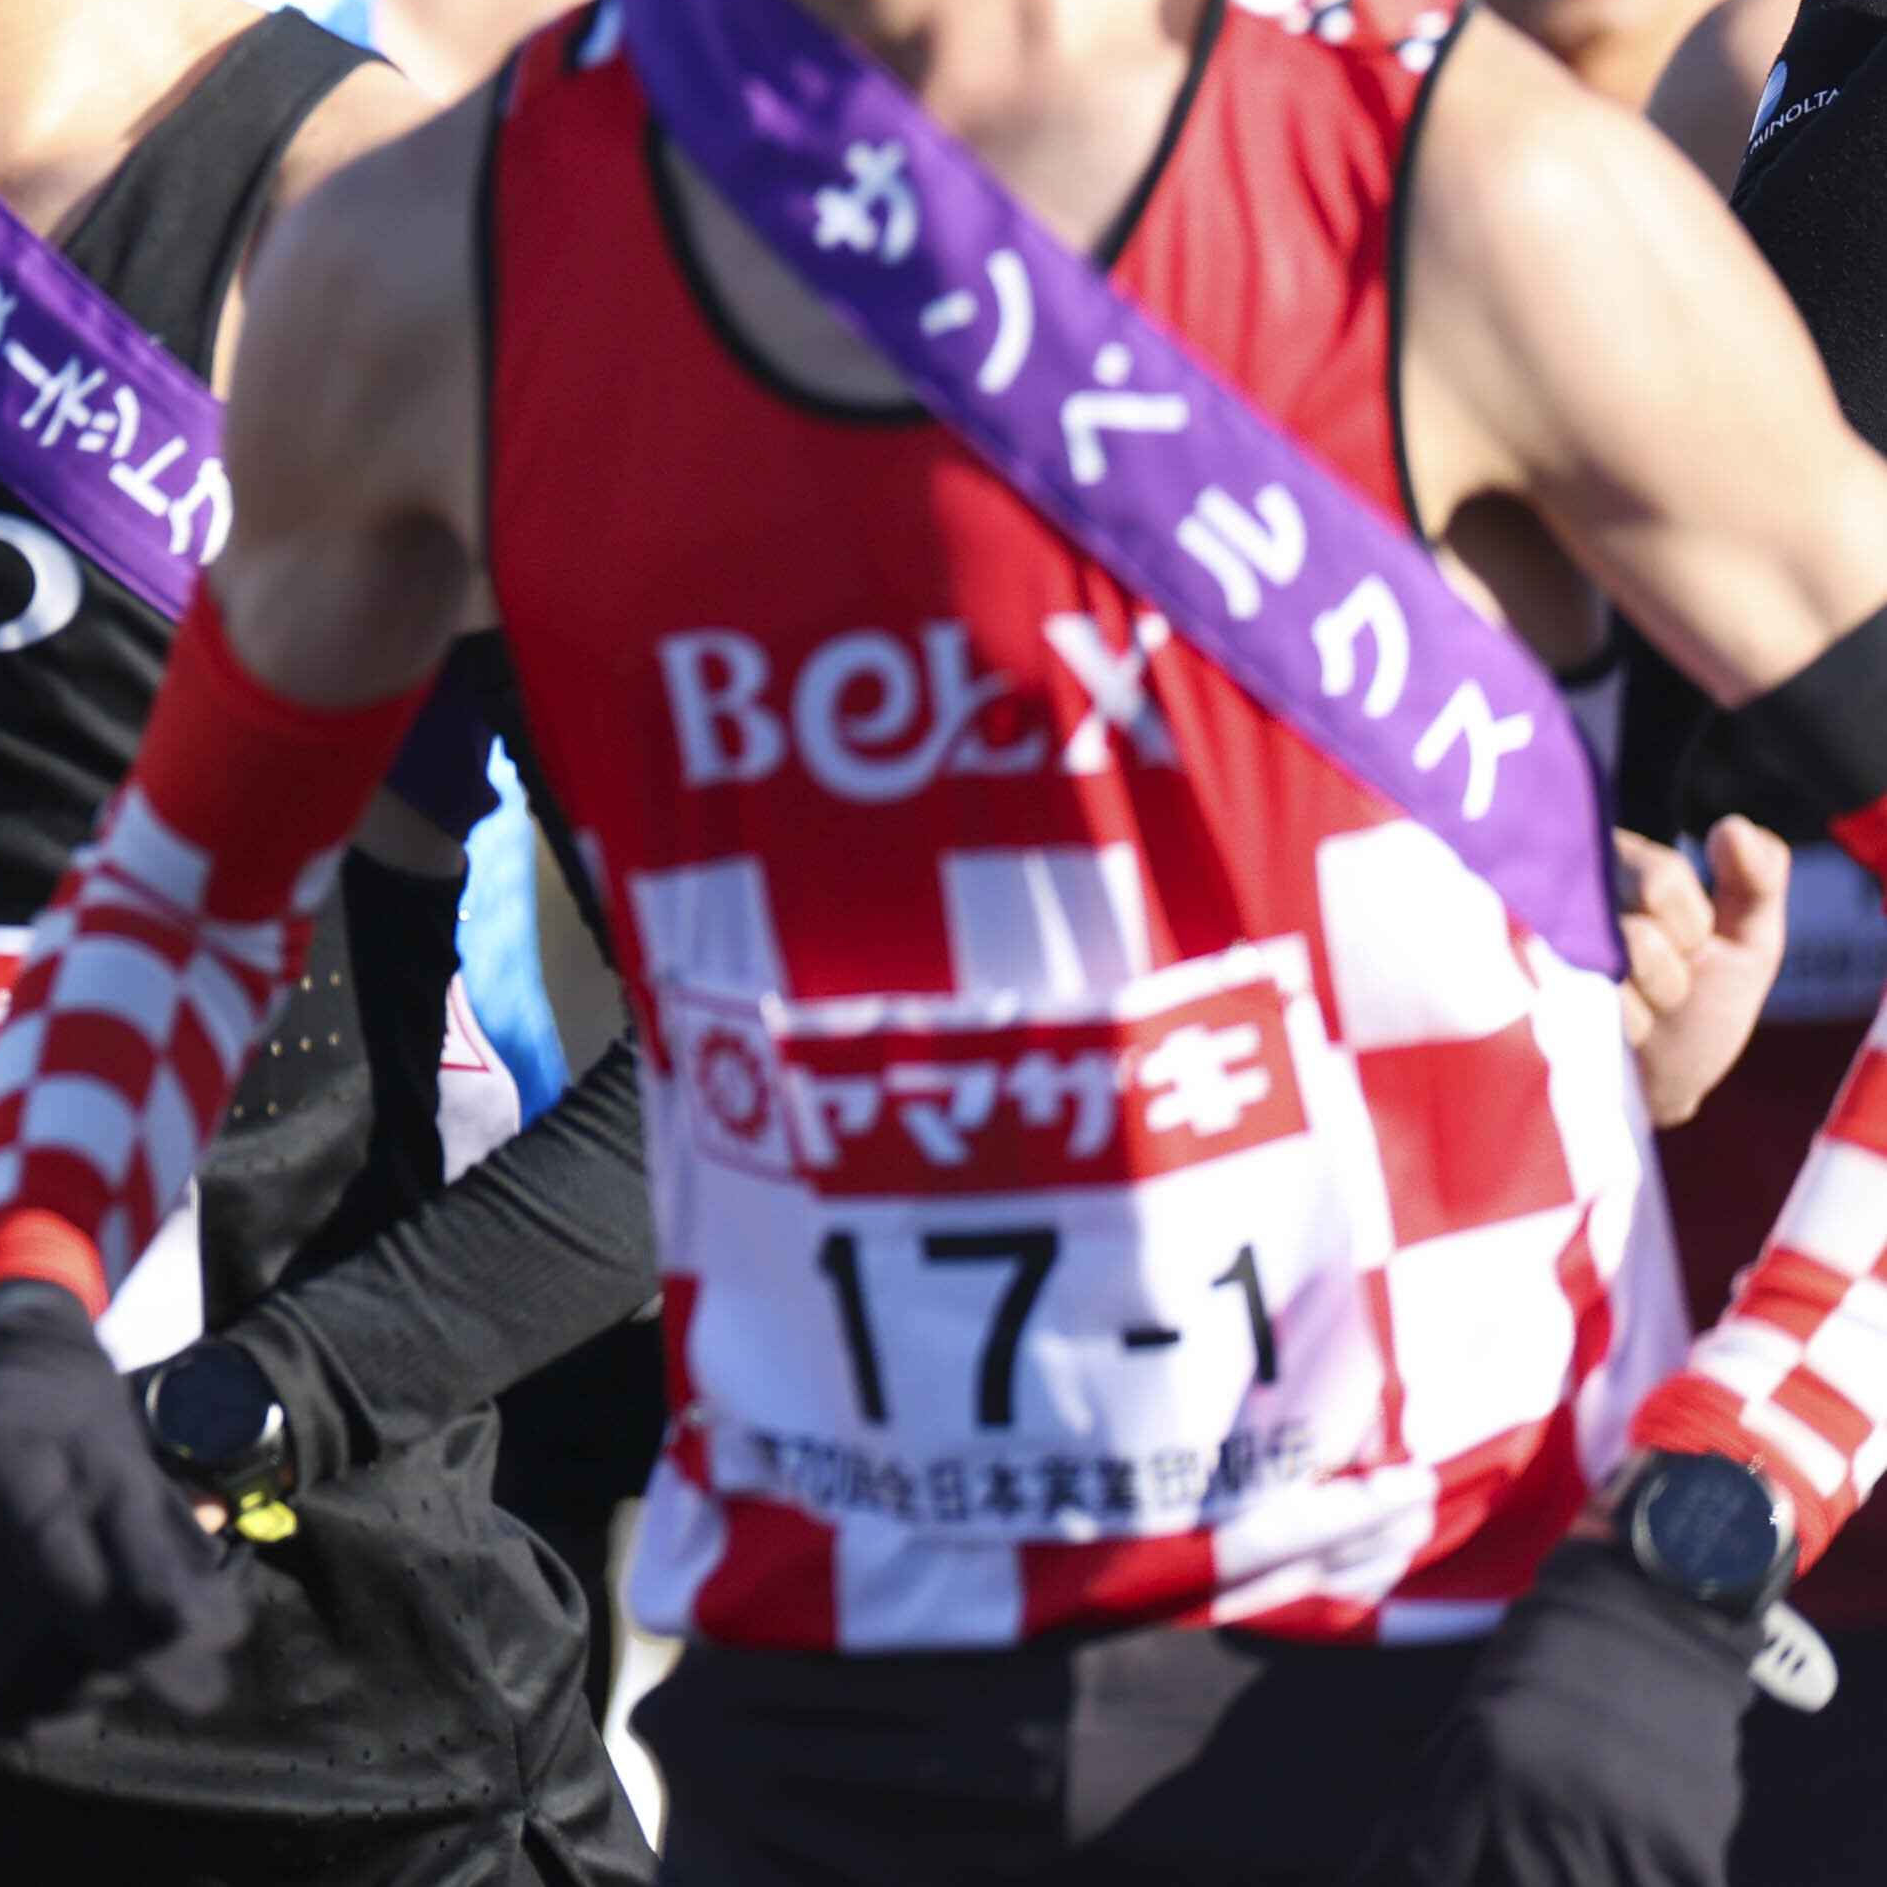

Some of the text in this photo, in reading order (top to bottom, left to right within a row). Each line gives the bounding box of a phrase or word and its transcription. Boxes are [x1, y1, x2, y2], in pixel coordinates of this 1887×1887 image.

[1748, 87, 1840, 155] MINOLTA
[813, 139, 1534, 822] サンベルクス
[815, 1226, 1277, 1429] 17-1
